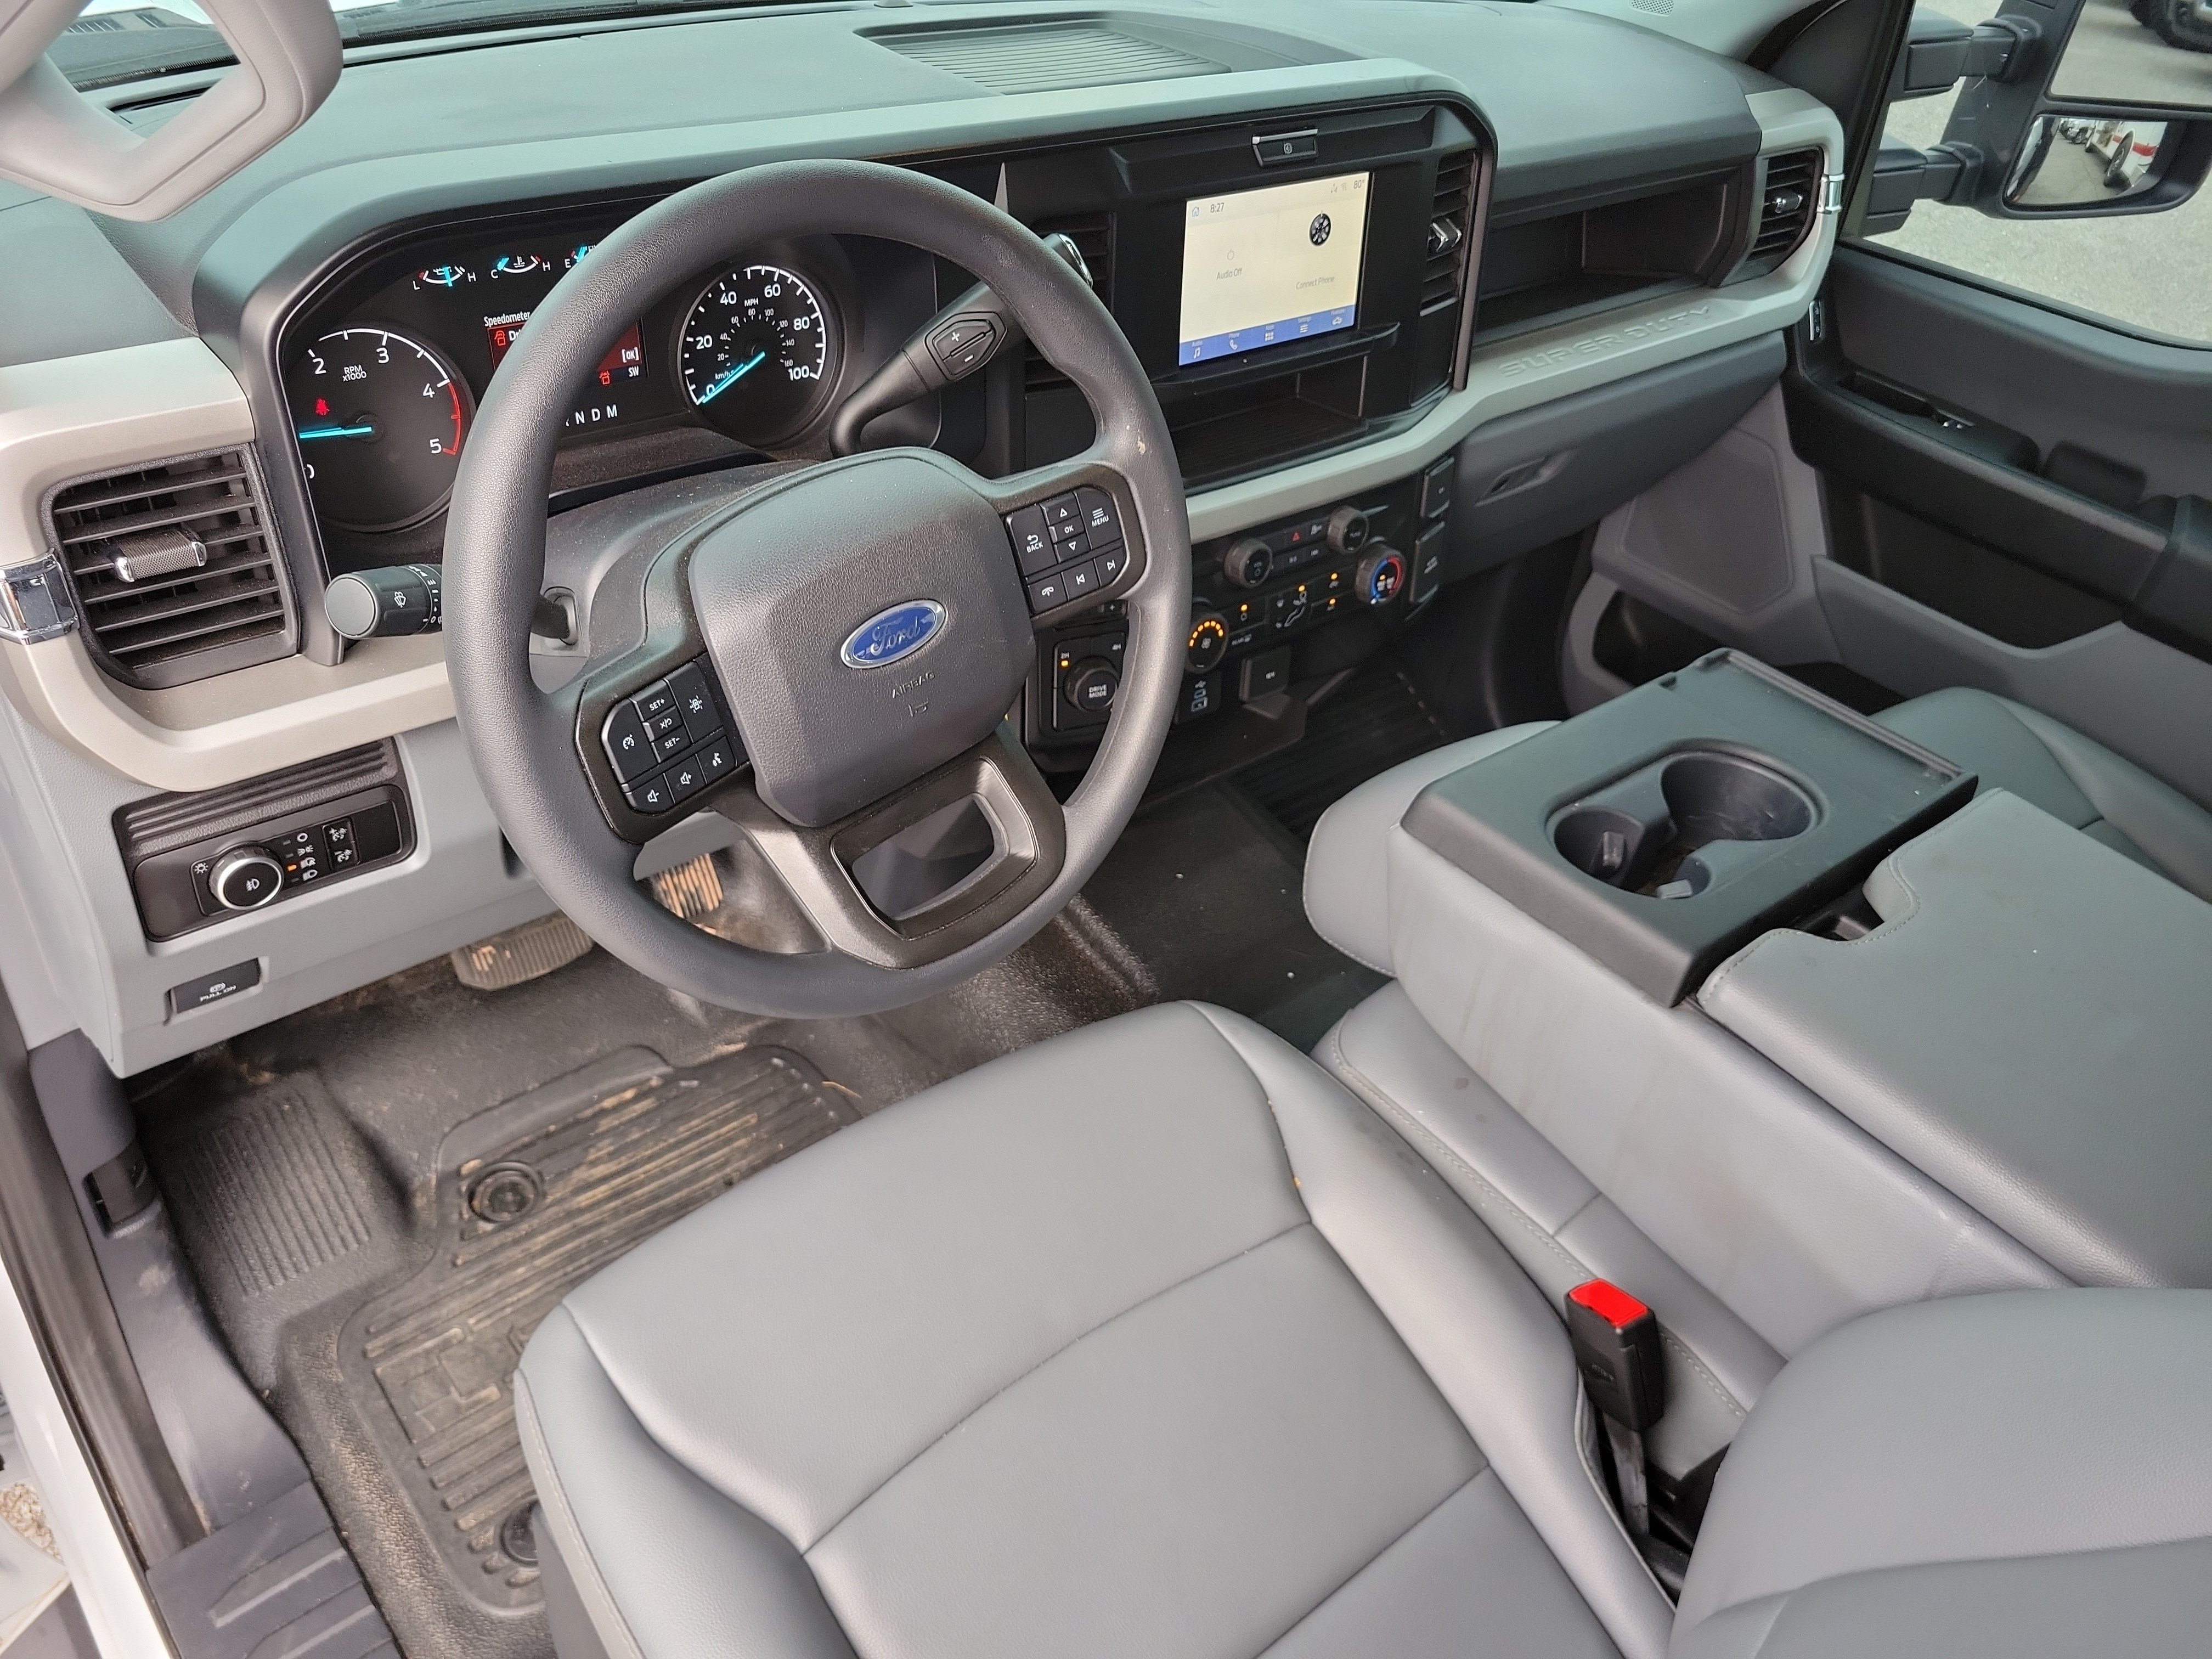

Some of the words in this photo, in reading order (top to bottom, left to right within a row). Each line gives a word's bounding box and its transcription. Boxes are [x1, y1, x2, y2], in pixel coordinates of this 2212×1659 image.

[1210, 202, 1224, 213] 8:27
[565, 258, 572, 268] E
[490, 269, 498, 279] C
[543, 261, 551, 272] H
[1216, 270, 1233, 280] Audio
[1234, 267, 1243, 276] Off
[413, 280, 420, 290] L
[467, 272, 476, 282] H
[1296, 279, 1317, 290] Connect
[1318, 276, 1335, 286] Phone
[764, 283, 781, 298] 60
[719, 291, 737, 305] 40
[744, 297, 759, 307] MPH
[764, 308, 774, 316] 100
[483, 311, 530, 328] Speedometer
[780, 319, 788, 328] 120
[793, 316, 810, 331] 80
[696, 335, 713, 350] 20
[720, 332, 727, 341] 40
[786, 338, 795, 347] 140
[1499, 334, 1623, 377] SUPER
[1624, 306, 1709, 338] DUTY
[376, 347, 390, 364] 3
[717, 352, 725, 361] 20
[313, 358, 326, 374] 2
[344, 364, 363, 374] RPM
[628, 365, 639, 377] SW
[342, 371, 367, 382] x1000
[715, 370, 731, 380] km/h
[788, 365, 810, 381] 100
[423, 383, 435, 398] 4
[706, 383, 715, 396] 0
[575, 410, 585, 425] N
[591, 408, 601, 421] D
[606, 404, 618, 419] M
[430, 439, 442, 454] 5
[1091, 515, 1109, 527] MENU
[1064, 525, 1074, 534] OK
[1026, 542, 1043, 553] BACK
[871, 616, 921, 656] Ford
[893, 673, 935, 698] AIRBAG
[649, 698, 665, 711] SET+
